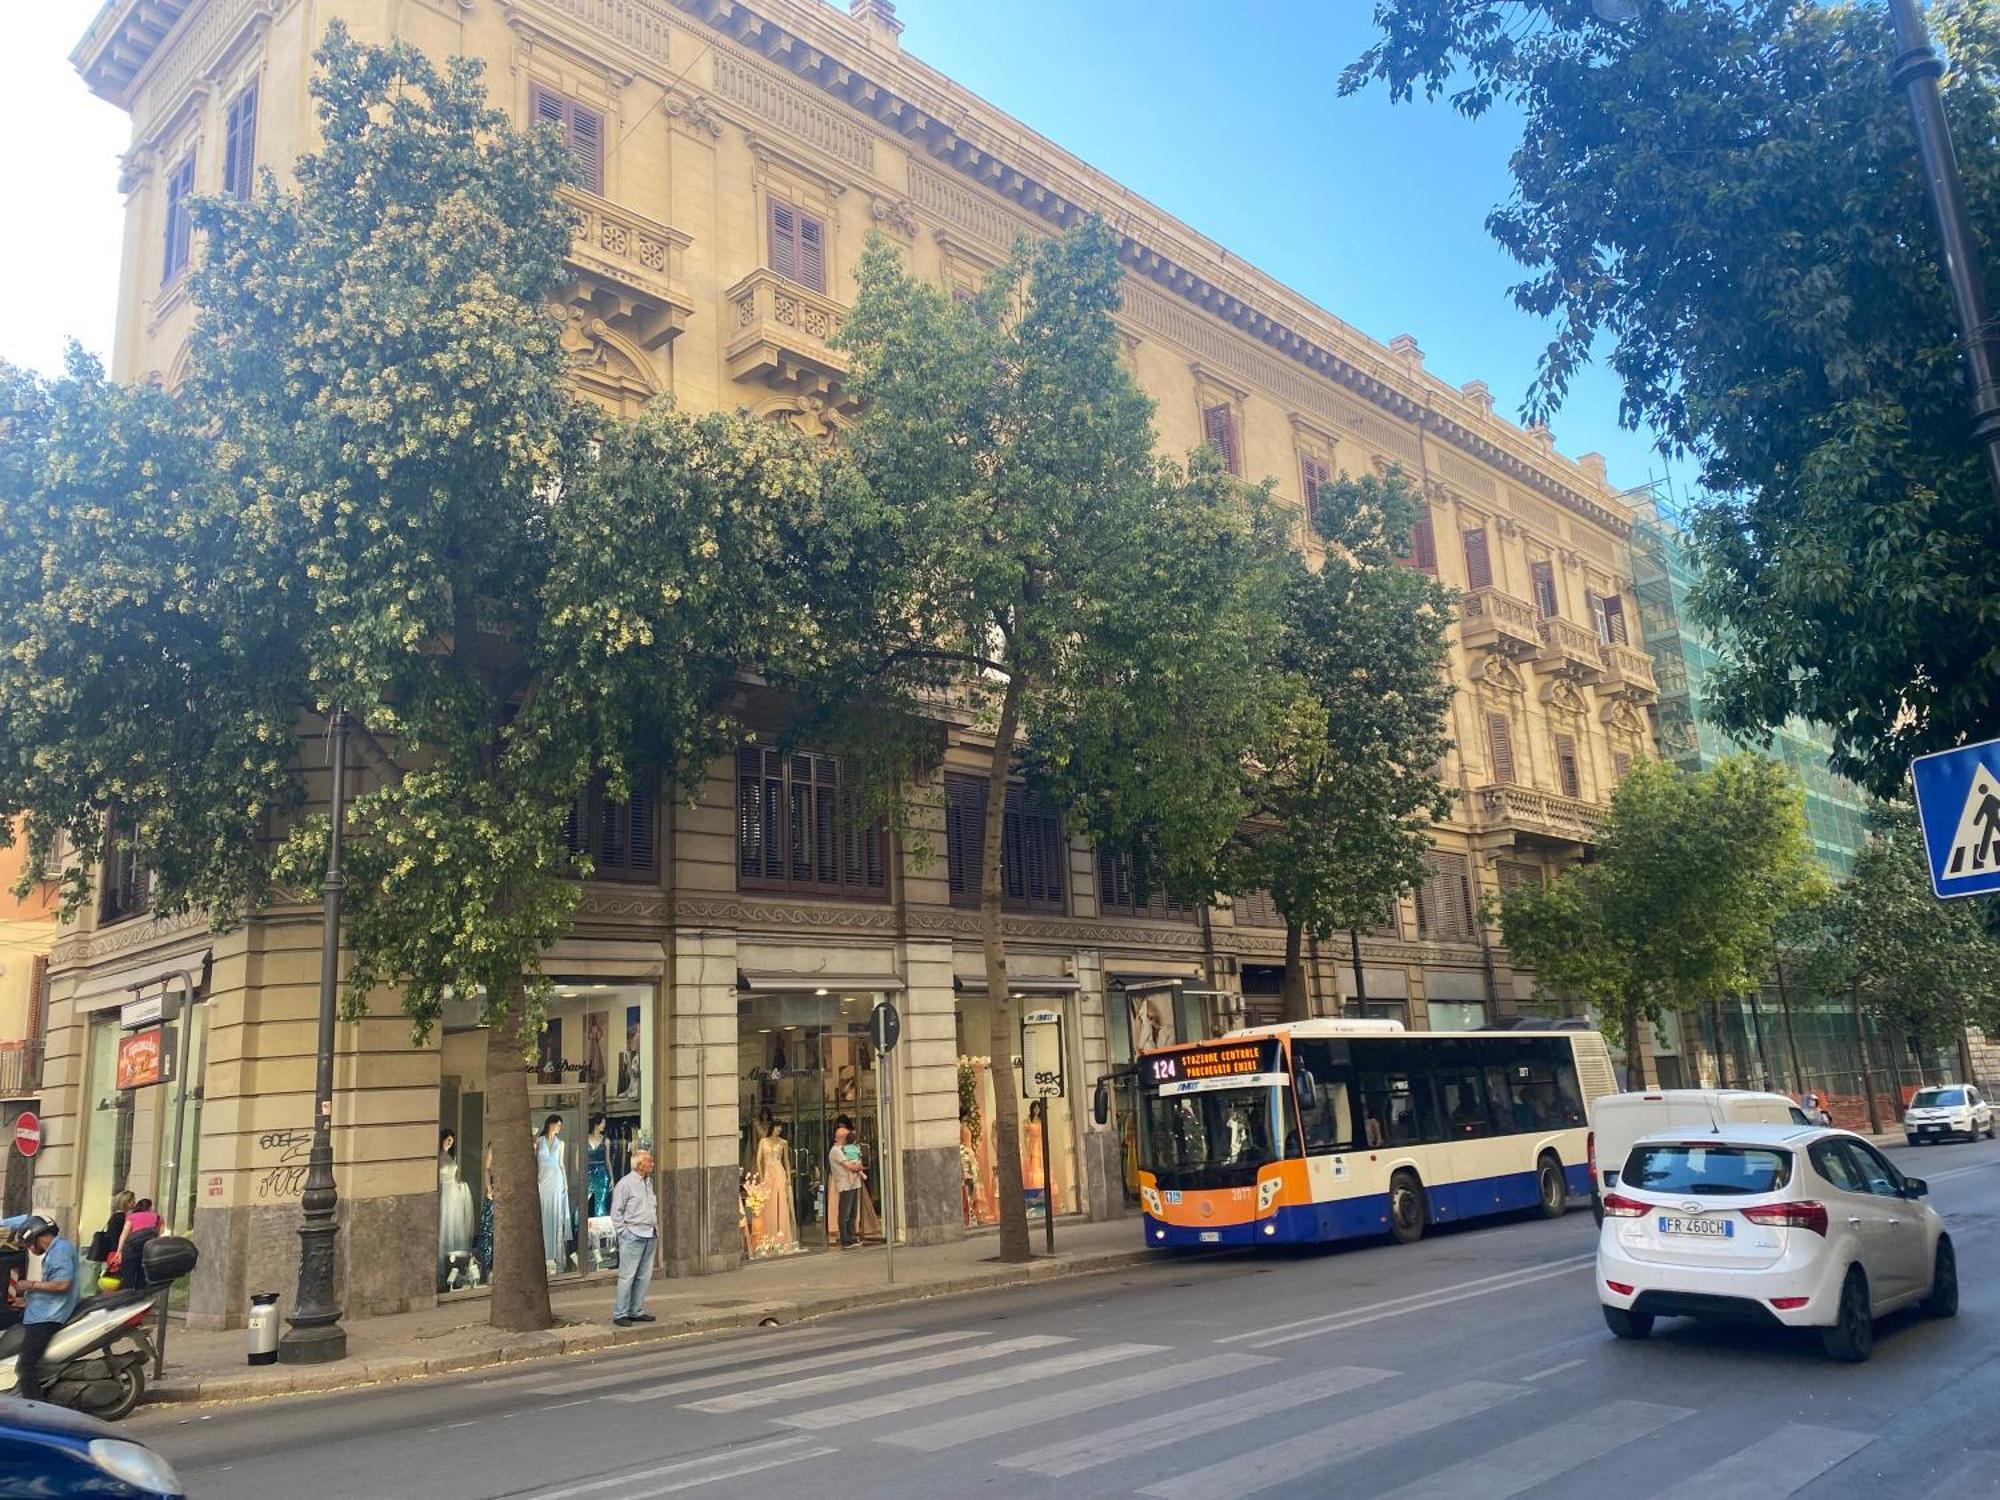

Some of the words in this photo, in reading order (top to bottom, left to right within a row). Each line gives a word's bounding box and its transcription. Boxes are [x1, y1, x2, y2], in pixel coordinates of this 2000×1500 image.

[1182, 1052, 1218, 1065] STAZIONE
[1221, 1047, 1260, 1061] CENTRALE
[1153, 1060, 1176, 1079] 124
[1667, 1220, 1681, 1232] FR
[1686, 1220, 1724, 1234] 460CH
